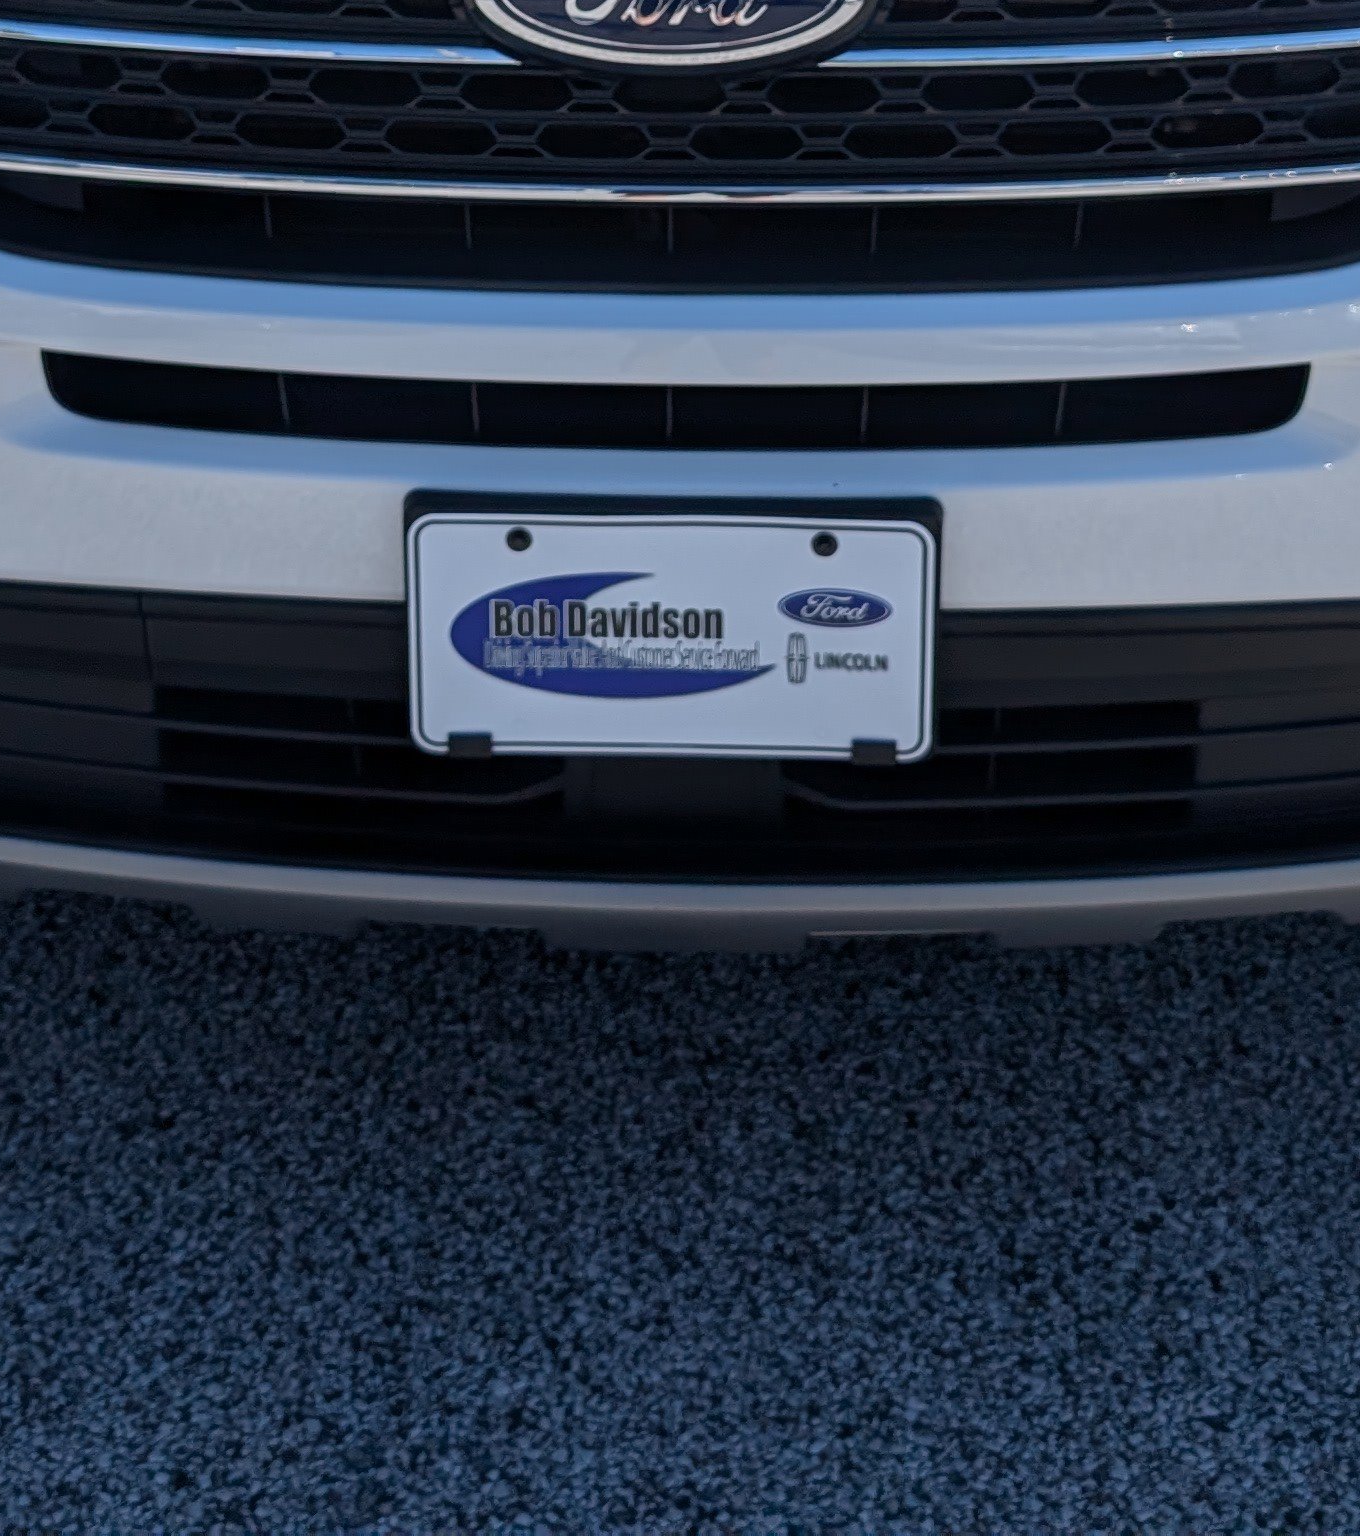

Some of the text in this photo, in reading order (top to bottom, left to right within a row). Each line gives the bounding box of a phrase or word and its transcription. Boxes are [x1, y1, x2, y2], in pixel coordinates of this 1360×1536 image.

[492, 599, 725, 640] Bob Davidson
[800, 593, 870, 620] Ford
[813, 651, 889, 672] LINCOLN
